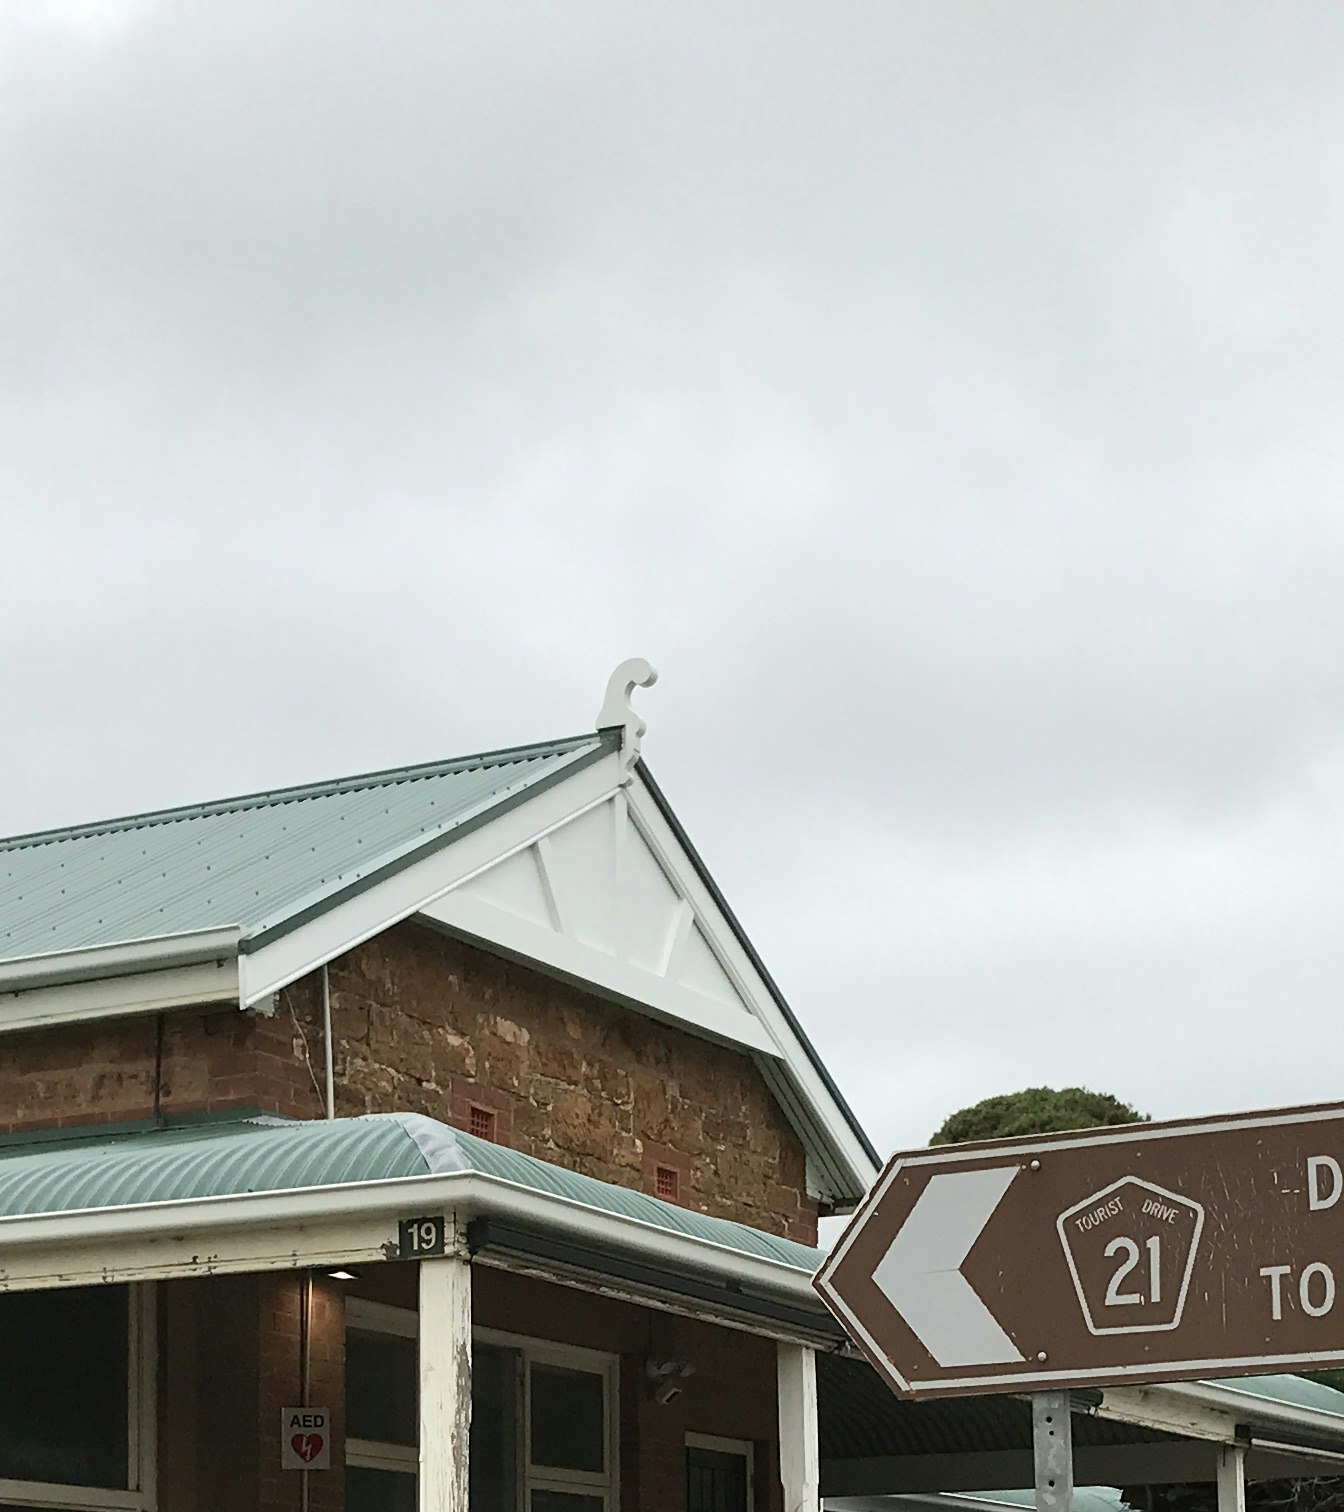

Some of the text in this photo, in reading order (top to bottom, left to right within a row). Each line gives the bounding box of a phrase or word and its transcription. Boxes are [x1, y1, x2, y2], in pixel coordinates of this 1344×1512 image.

[1074, 1196, 1180, 1233] TOURIST DRIVE
[408, 1222, 436, 1251] 19
[1104, 1235, 1161, 1306] 21
[289, 1414, 325, 1428] AED
